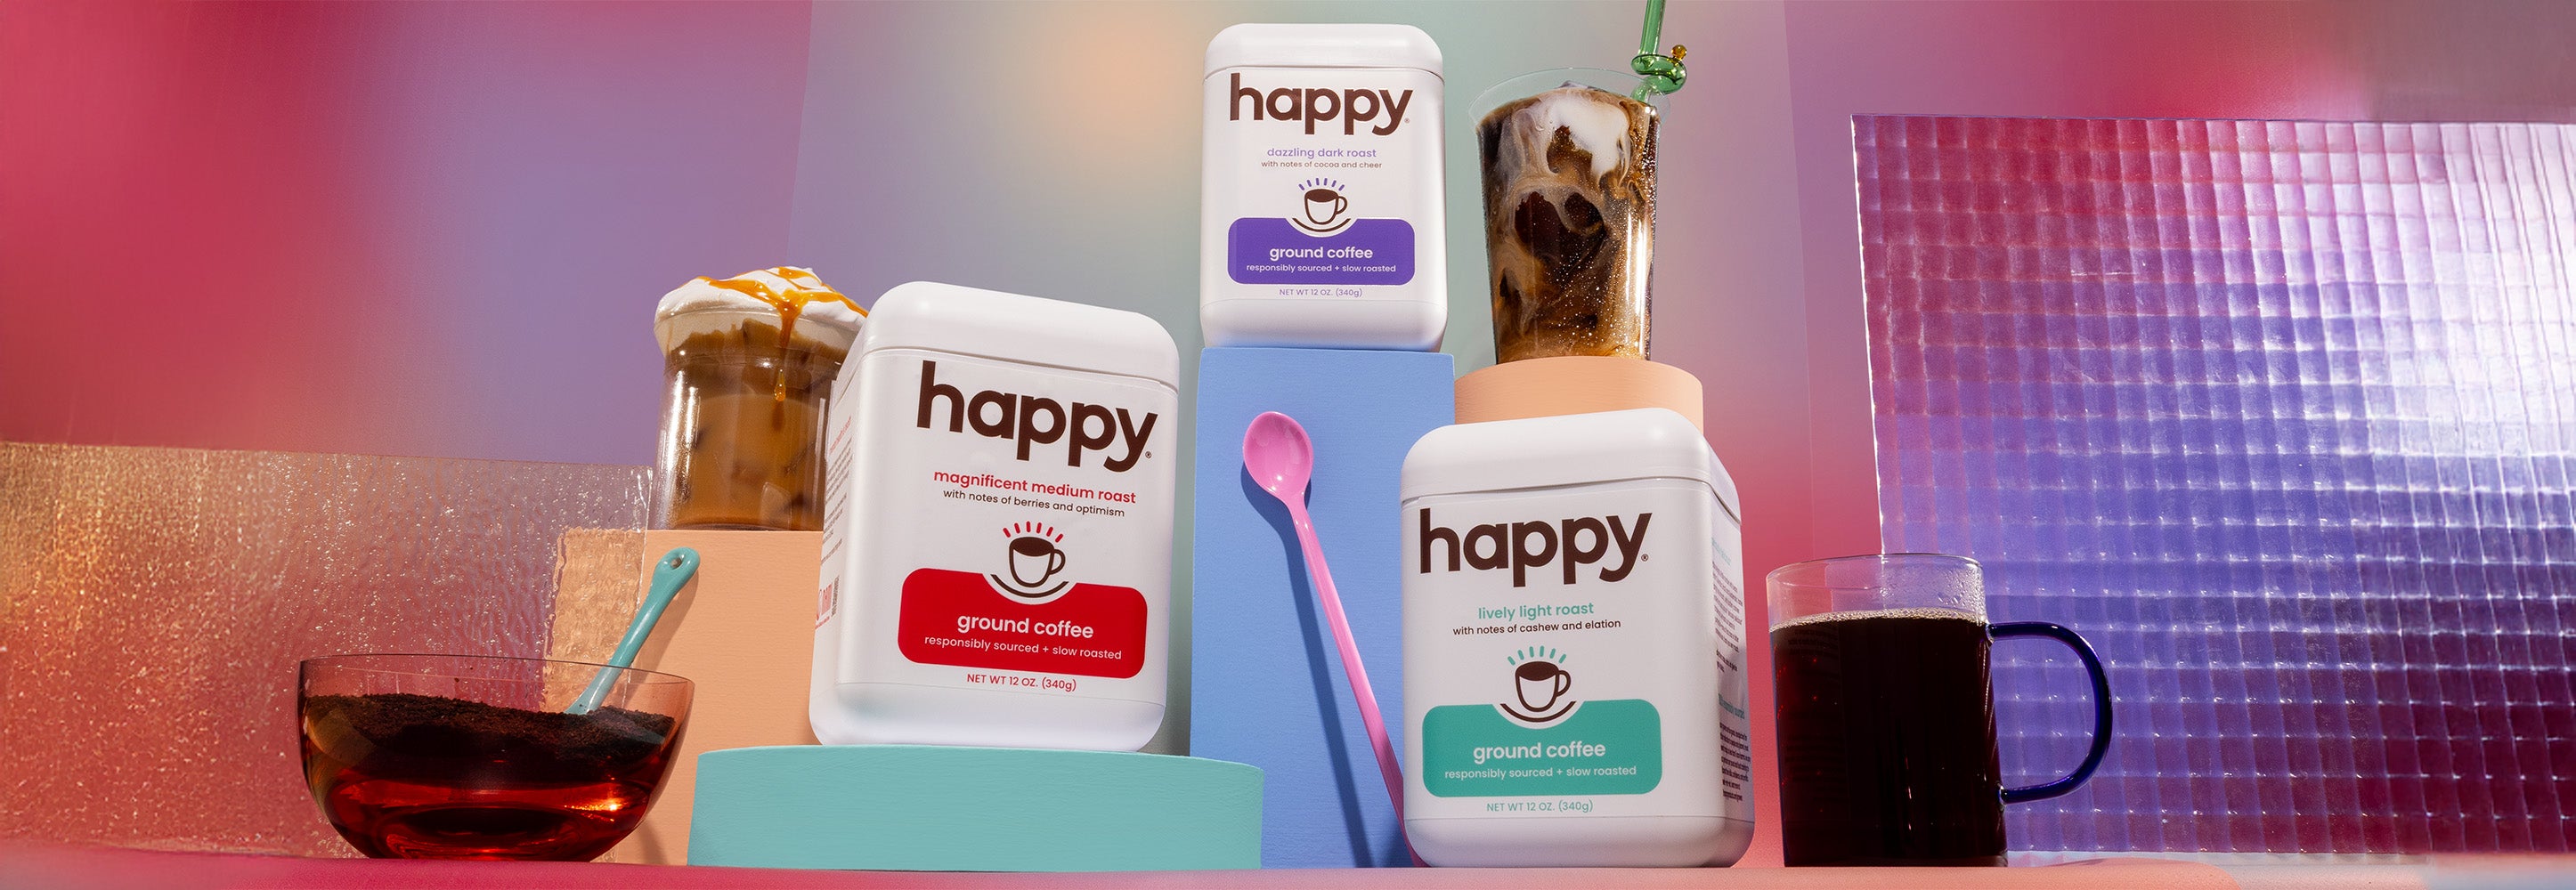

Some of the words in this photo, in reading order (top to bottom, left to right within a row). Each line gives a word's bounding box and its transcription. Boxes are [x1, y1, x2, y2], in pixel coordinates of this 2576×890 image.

[1266, 147, 1315, 160] dazzling
[1317, 148, 1344, 158] dark
[1346, 149, 1377, 158] roast
[1304, 160, 1312, 168] of
[1358, 161, 1383, 169] cheer
[1270, 247, 1323, 261] ground
[1326, 246, 1374, 259] coffee
[1246, 263, 1296, 273] responsibly
[1297, 264, 1333, 272] sourced
[1342, 264, 1361, 272] slow
[1362, 264, 1397, 272] roasted
[1279, 288, 1294, 296] NET
[1310, 288, 1319, 296] 12
[1320, 288, 1334, 296] OZ.
[1335, 287, 1363, 298] (340g)
[934, 472, 1028, 491] magnificent
[1032, 483, 1093, 498] medium
[1098, 490, 1137, 504] roast
[943, 489, 966, 499] with
[968, 493, 998, 504] notes
[1000, 496, 1012, 505] of
[1013, 496, 1051, 510] berries
[1052, 503, 1074, 512] and
[1075, 505, 1125, 517] optimism
[1479, 607, 1516, 621] lively
[1520, 605, 1551, 620] light
[1556, 603, 1595, 616] roast
[958, 616, 1029, 633] ground
[1035, 620, 1093, 638] coffee
[1452, 626, 1475, 635] with
[1476, 626, 1505, 635] notes
[1507, 623, 1517, 634] of
[1519, 622, 1560, 633] cashew
[1561, 620, 1582, 631] and
[1584, 619, 1621, 629] elation
[925, 637, 990, 651] responsibly
[993, 642, 1039, 653] sourced
[1052, 645, 1078, 656] slow
[1079, 649, 1122, 659] roasted
[966, 673, 987, 684] NET
[989, 675, 1007, 685] WT
[1009, 676, 1020, 686] 12
[1021, 677, 1039, 688] OZ.
[1042, 676, 1076, 692] (340g)
[1474, 742, 1540, 765] ground
[1547, 740, 1605, 757] coffee
[1444, 768, 1507, 781] responsibly
[1508, 766, 1554, 778] sourced
[1566, 766, 1591, 777] slow
[1593, 765, 1637, 776] roasted
[1486, 802, 1506, 813] NET
[1507, 802, 1524, 812] WT
[1526, 802, 1536, 812] 12
[1538, 802, 1556, 812] OZ.
[1558, 798, 1594, 813] (340g)
